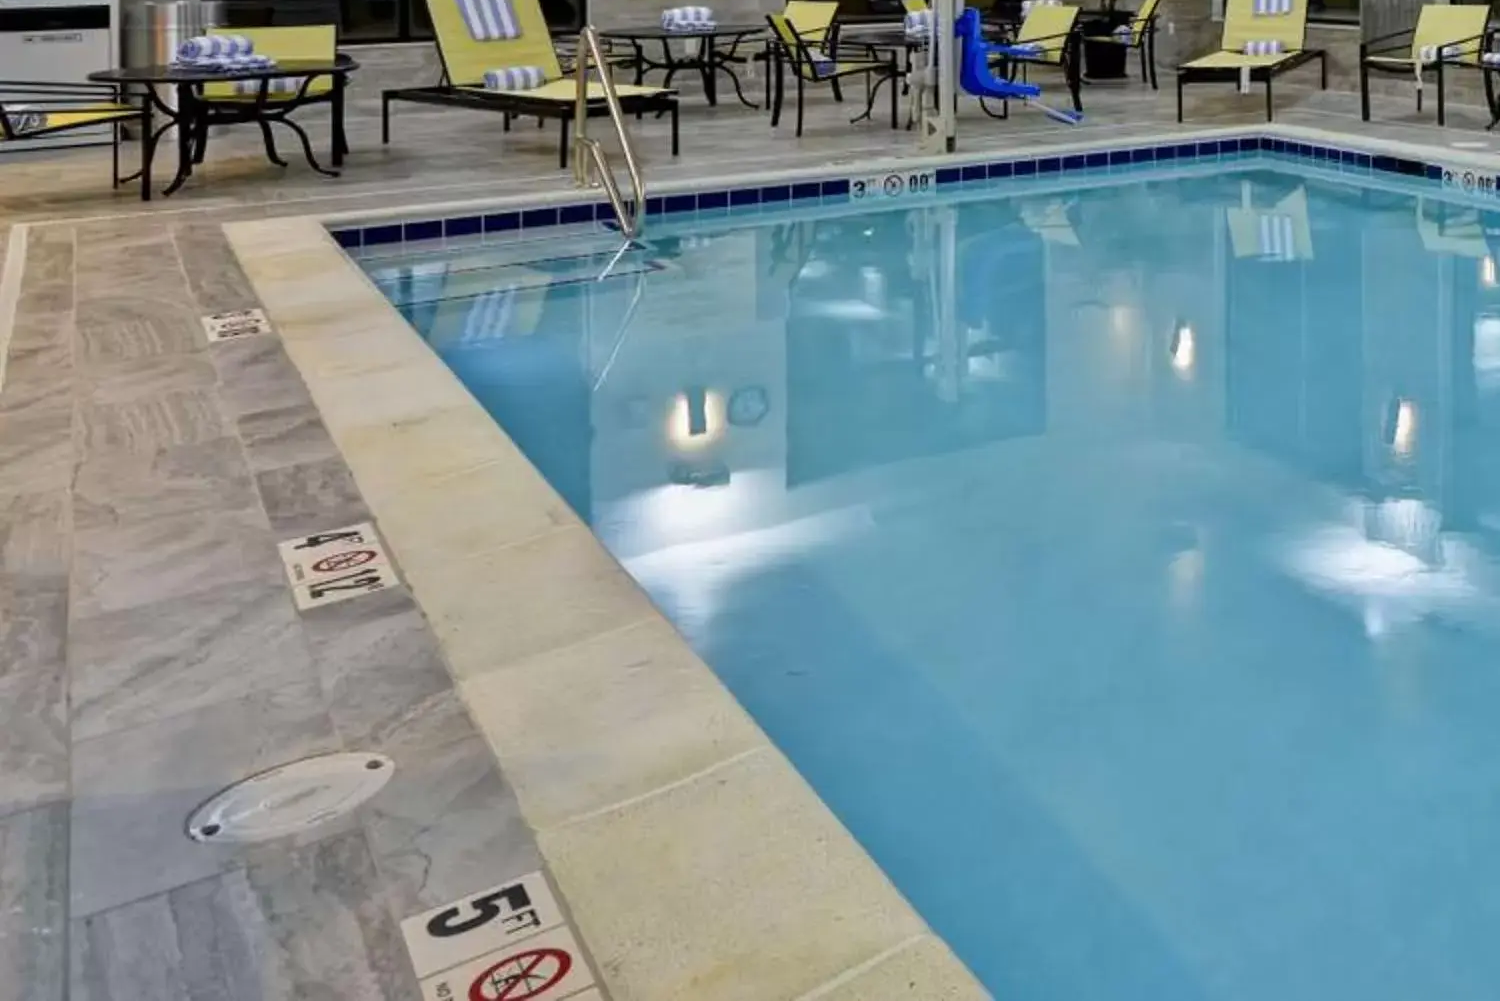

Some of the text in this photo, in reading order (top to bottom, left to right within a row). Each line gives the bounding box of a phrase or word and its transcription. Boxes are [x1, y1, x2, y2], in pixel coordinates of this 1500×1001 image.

[293, 530, 360, 550] 4
[426, 883, 542, 938] 5 FT
